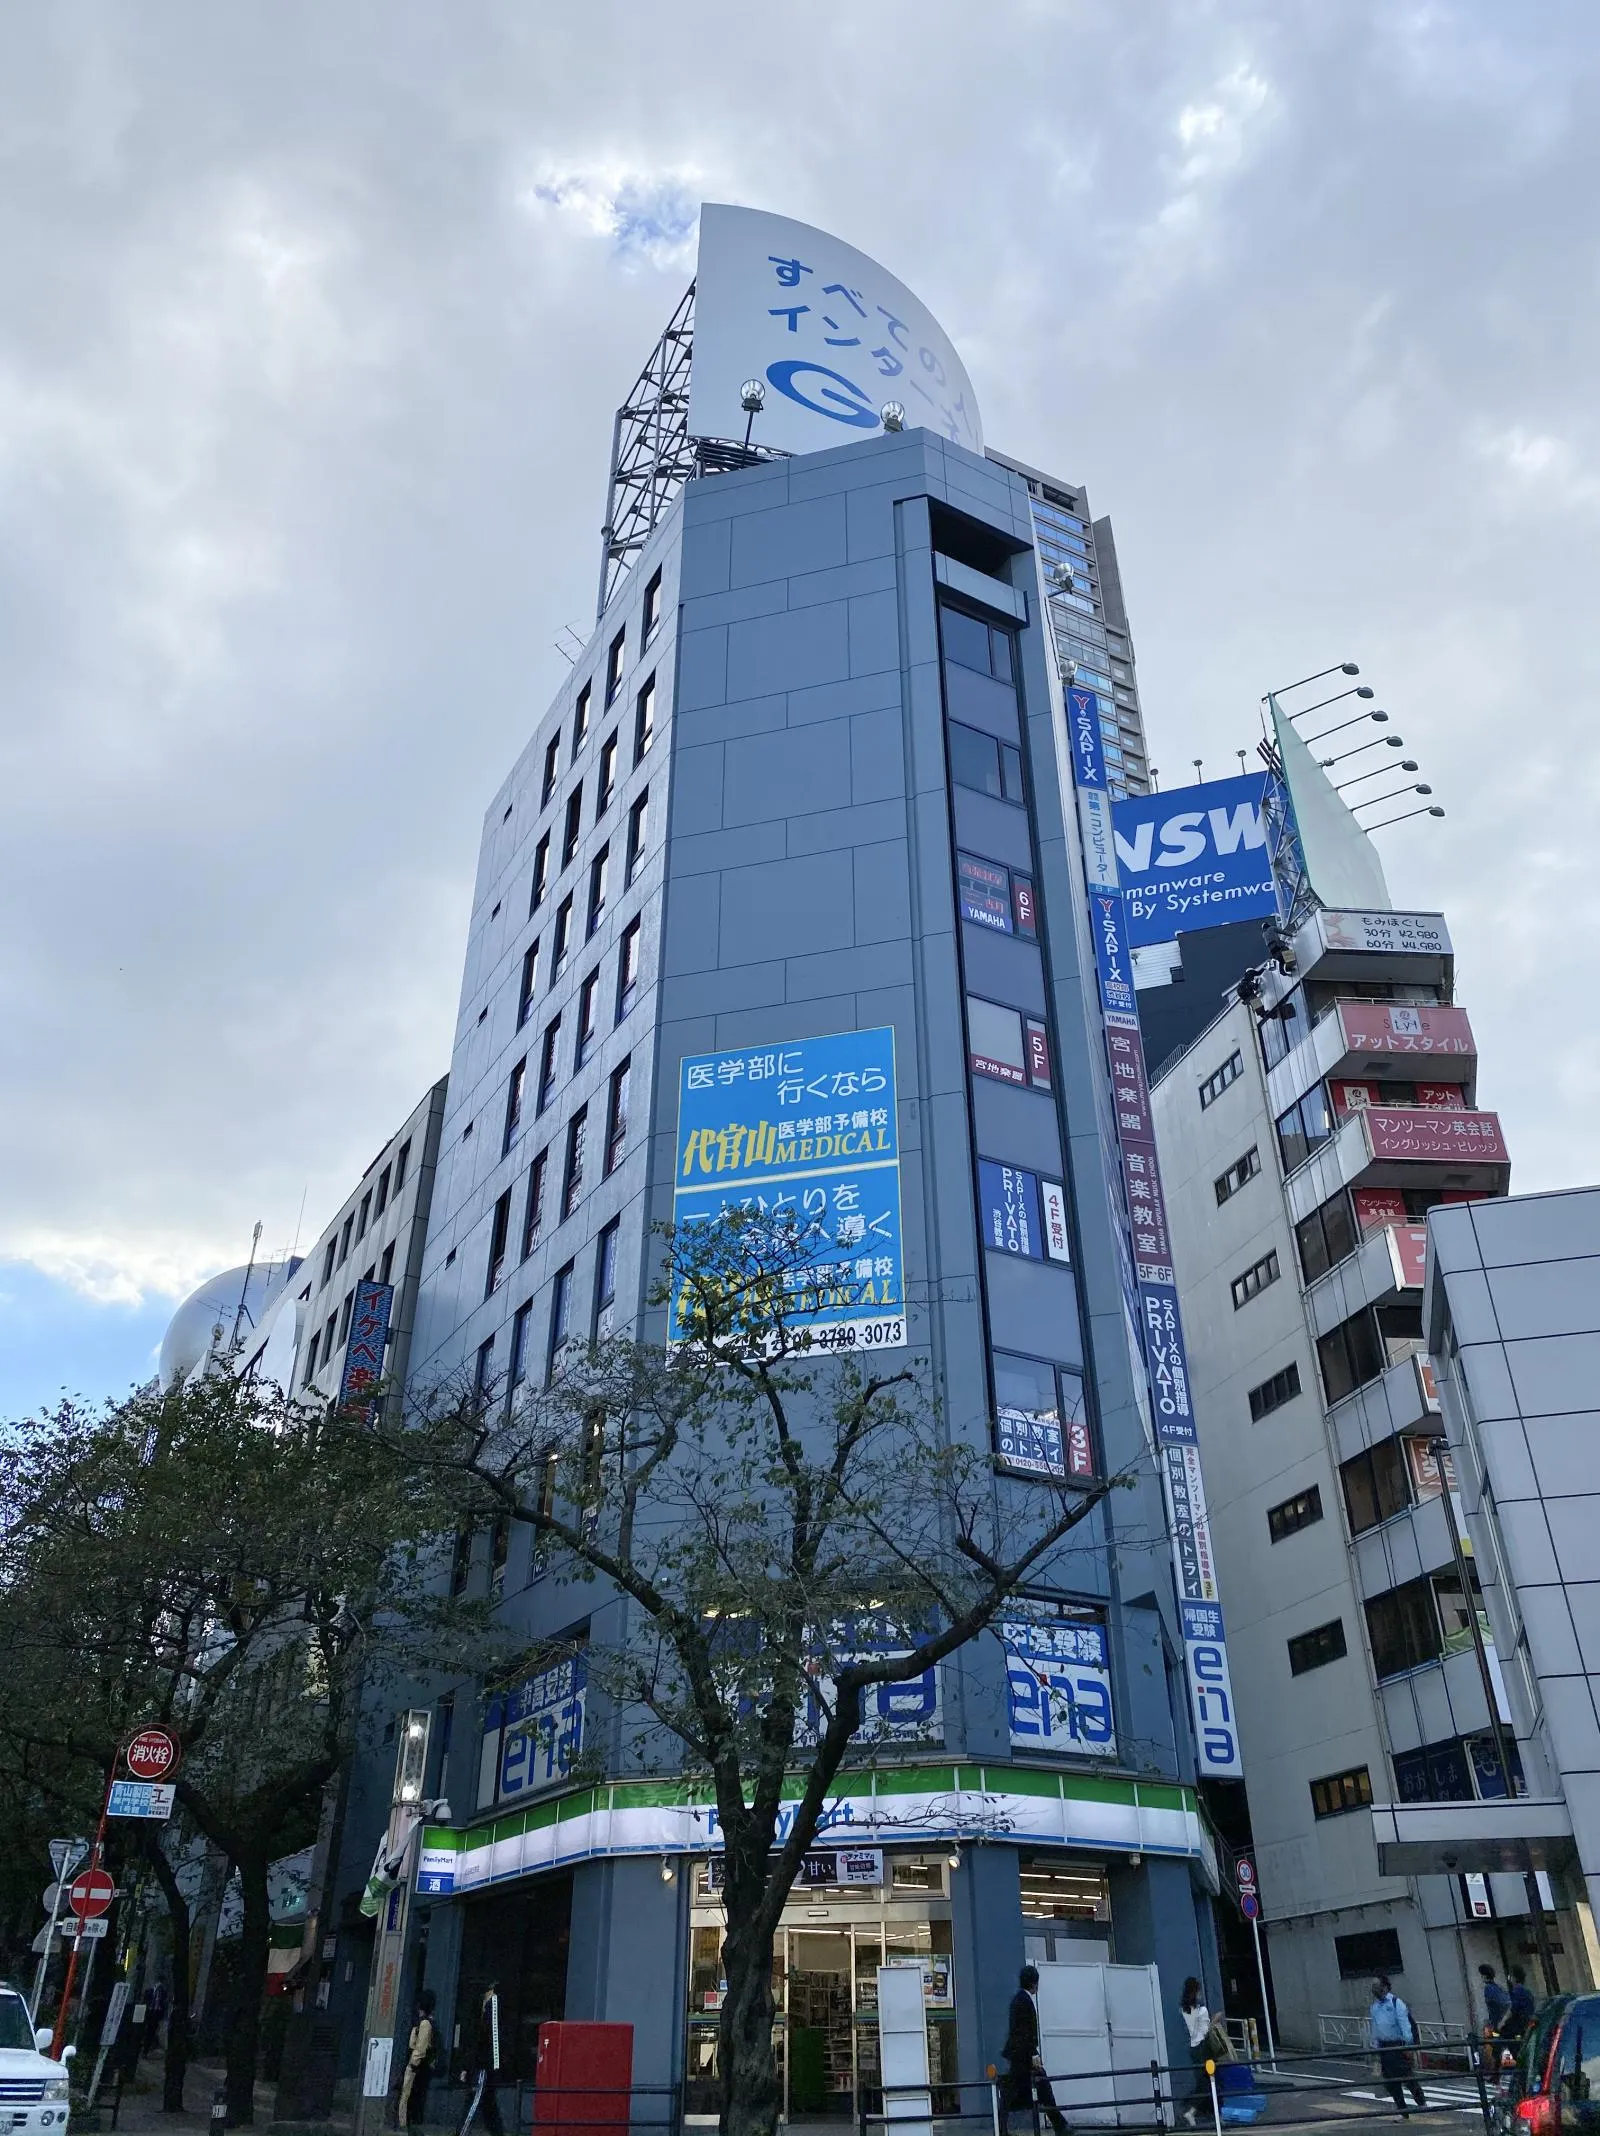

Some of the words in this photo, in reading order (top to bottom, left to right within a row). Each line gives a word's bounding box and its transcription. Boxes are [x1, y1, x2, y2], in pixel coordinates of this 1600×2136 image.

[968, 906, 1006, 929] YAMAHA
[1019, 891, 1031, 921] 6F
[1132, 901, 1157, 920] By
[1361, 916, 1425, 928] もみほぐし
[1363, 928, 1391, 939] 30分
[1366, 940, 1394, 950] 60分
[1106, 1014, 1137, 1026] YAMAHA
[1032, 1036, 1045, 1070] 5F
[1351, 1033, 1469, 1053] アットスタイル
[688, 1051, 804, 1090] 医学部に
[1110, 1036, 1141, 1131] 宮地楽器
[776, 1067, 888, 1105] 行くなら
[1423, 1089, 1456, 1101] アット
[778, 1107, 889, 1140] 医学部予備校
[1375, 1118, 1495, 1138] マンツーマン英会話
[682, 1120, 778, 1177] 代官山
[774, 1128, 892, 1165] MEDICAL
[1002, 1167, 1019, 1252] PRIVATO
[1126, 1152, 1159, 1255] 音楽教室
[1360, 1199, 1400, 1207] マンツーマン
[1048, 1194, 1064, 1250] 4F受付
[1145, 1295, 1176, 1415] PRIVATO
[1162, 1299, 1190, 1417] SAPIXの個別指導
[999, 1417, 1060, 1445] 個別教室
[1161, 1424, 1193, 1437] 4F受付
[1001, 1437, 1060, 1462] のトライ
[1071, 1425, 1087, 1473] 3F
[1168, 1447, 1199, 1597] 個別教室のトライ
[1184, 1608, 1221, 1624] 帰国生
[1191, 1623, 1217, 1638] 受験
[131, 1744, 170, 1764] 消火栓
